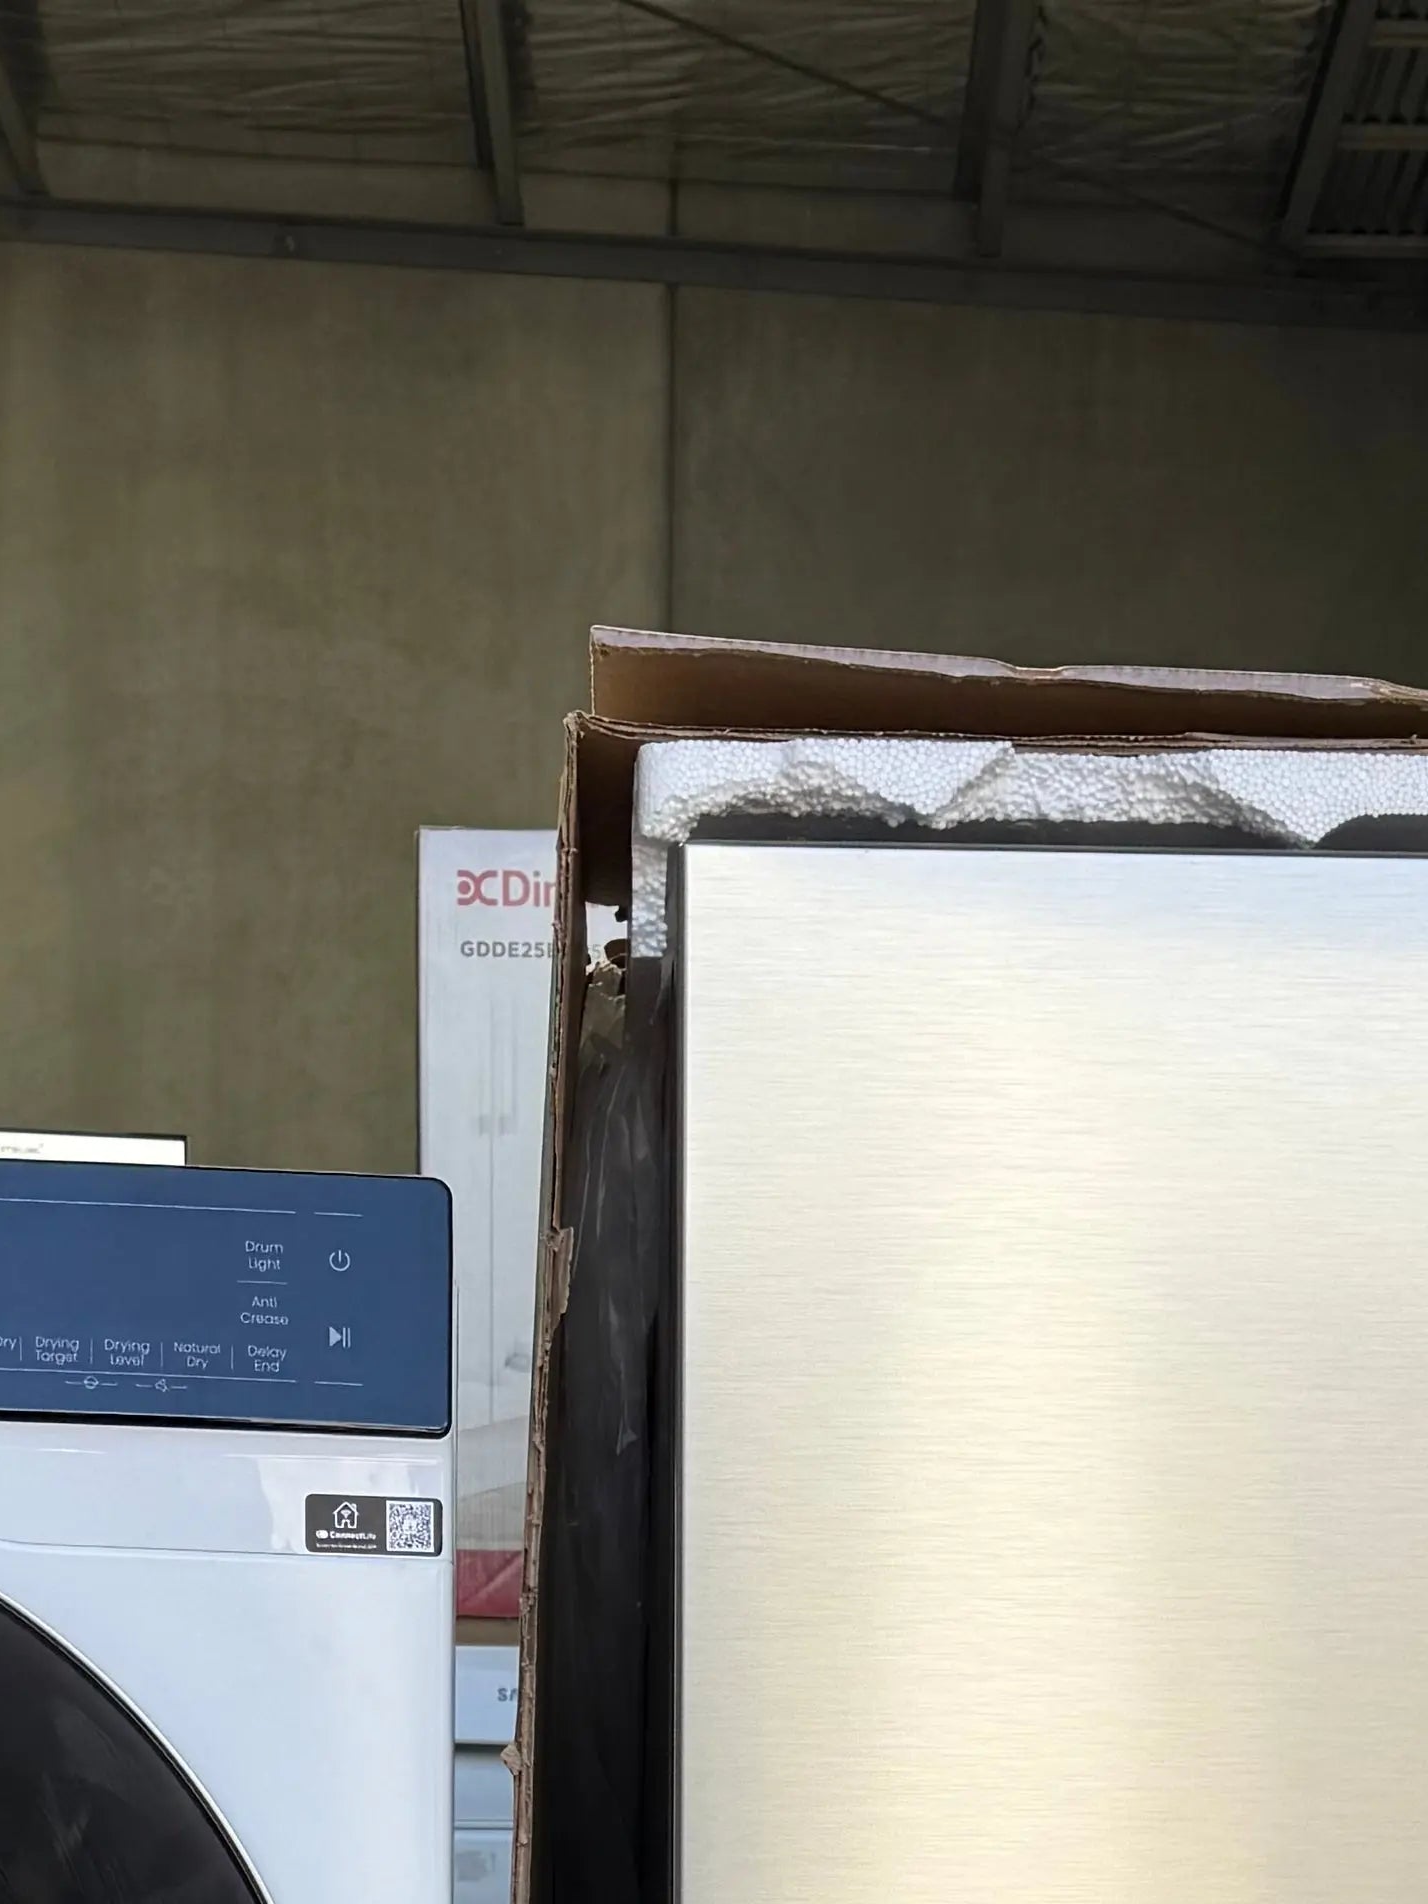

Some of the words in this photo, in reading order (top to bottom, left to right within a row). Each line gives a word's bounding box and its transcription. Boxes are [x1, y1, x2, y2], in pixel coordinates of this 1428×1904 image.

[245, 1240, 283, 1253] Drum
[249, 1259, 280, 1272] Light
[252, 1296, 277, 1307] Anti
[240, 1312, 289, 1325] Crease
[36, 1336, 79, 1352] Drying
[104, 1339, 150, 1354] Drying
[174, 1342, 221, 1354] Natural
[36, 1350, 78, 1365] Target
[248, 1345, 287, 1361] Delay
[110, 1354, 144, 1366] Level
[187, 1356, 208, 1370] Dry
[255, 1360, 280, 1372] End
